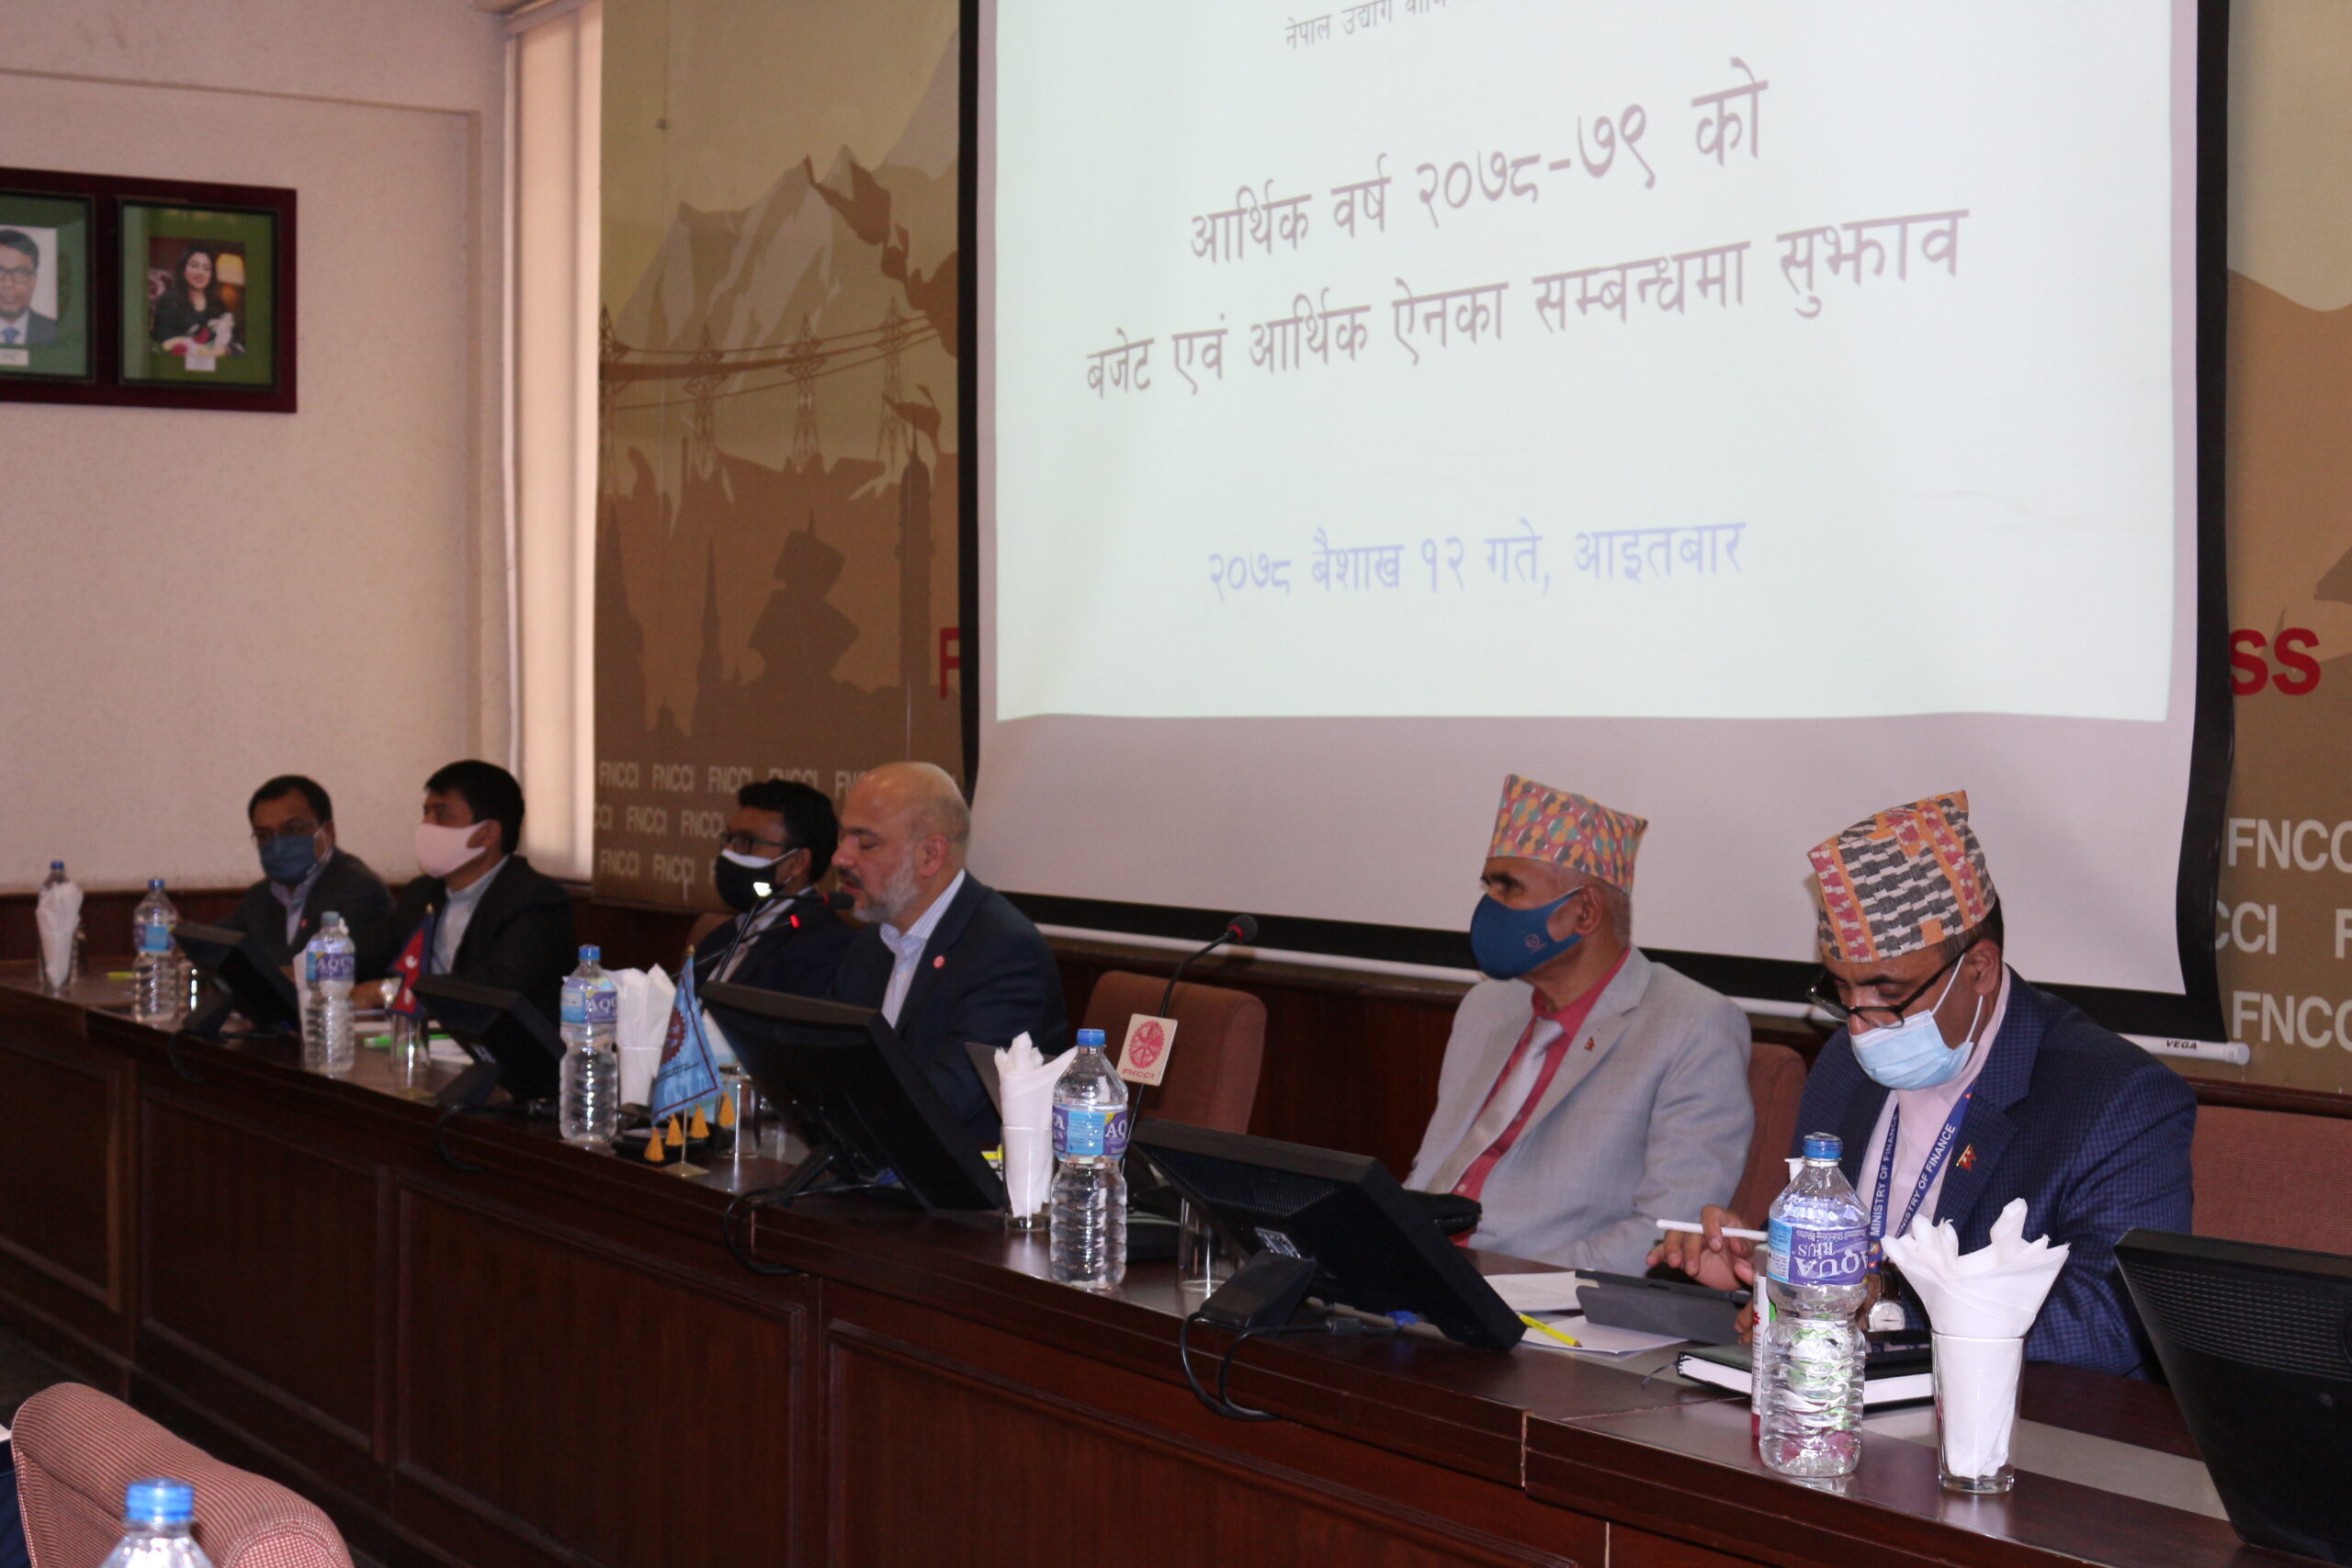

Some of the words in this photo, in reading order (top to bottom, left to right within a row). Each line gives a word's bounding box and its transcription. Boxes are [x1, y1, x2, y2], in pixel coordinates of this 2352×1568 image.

[1285, 17, 1332, 50] नेपाल
[1191, 178, 1313, 265] आर्थिक
[1329, 152, 1392, 239] वर्ष
[1690, 56, 1770, 167] को
[1086, 327, 1156, 400] बजेट
[1170, 315, 1229, 396] एवं
[1250, 287, 1372, 374] आर्थिक
[1391, 276, 1510, 367] ऐनका
[1531, 240, 1752, 333] सम्बन्धमा
[1208, 552, 1292, 603] २०७८
[1312, 526, 1405, 592] बैशाख
[1420, 536, 1464, 592] १२
[1484, 517, 1551, 595] गते,
[1574, 522, 1747, 584] आइतबार
[599, 761, 639, 789] FNCCI
[652, 763, 695, 793] FNCCI
[626, 806, 667, 836] FNCCI
[681, 809, 724, 839] FNCCI
[599, 850, 639, 877] FNCCI
[653, 853, 695, 884] FNCCI
[2165, 1040, 2198, 1050] VEGA
[1122, 1068, 1156, 1079] FNCCI
[1917, 1172, 1929, 1190] OF
[1926, 1122, 1956, 1173] FINANCE
[1870, 1183, 1886, 1236] MINISTRY
[1879, 1165, 1889, 1180] OF
[1793, 1248, 1869, 1280] AQUA
